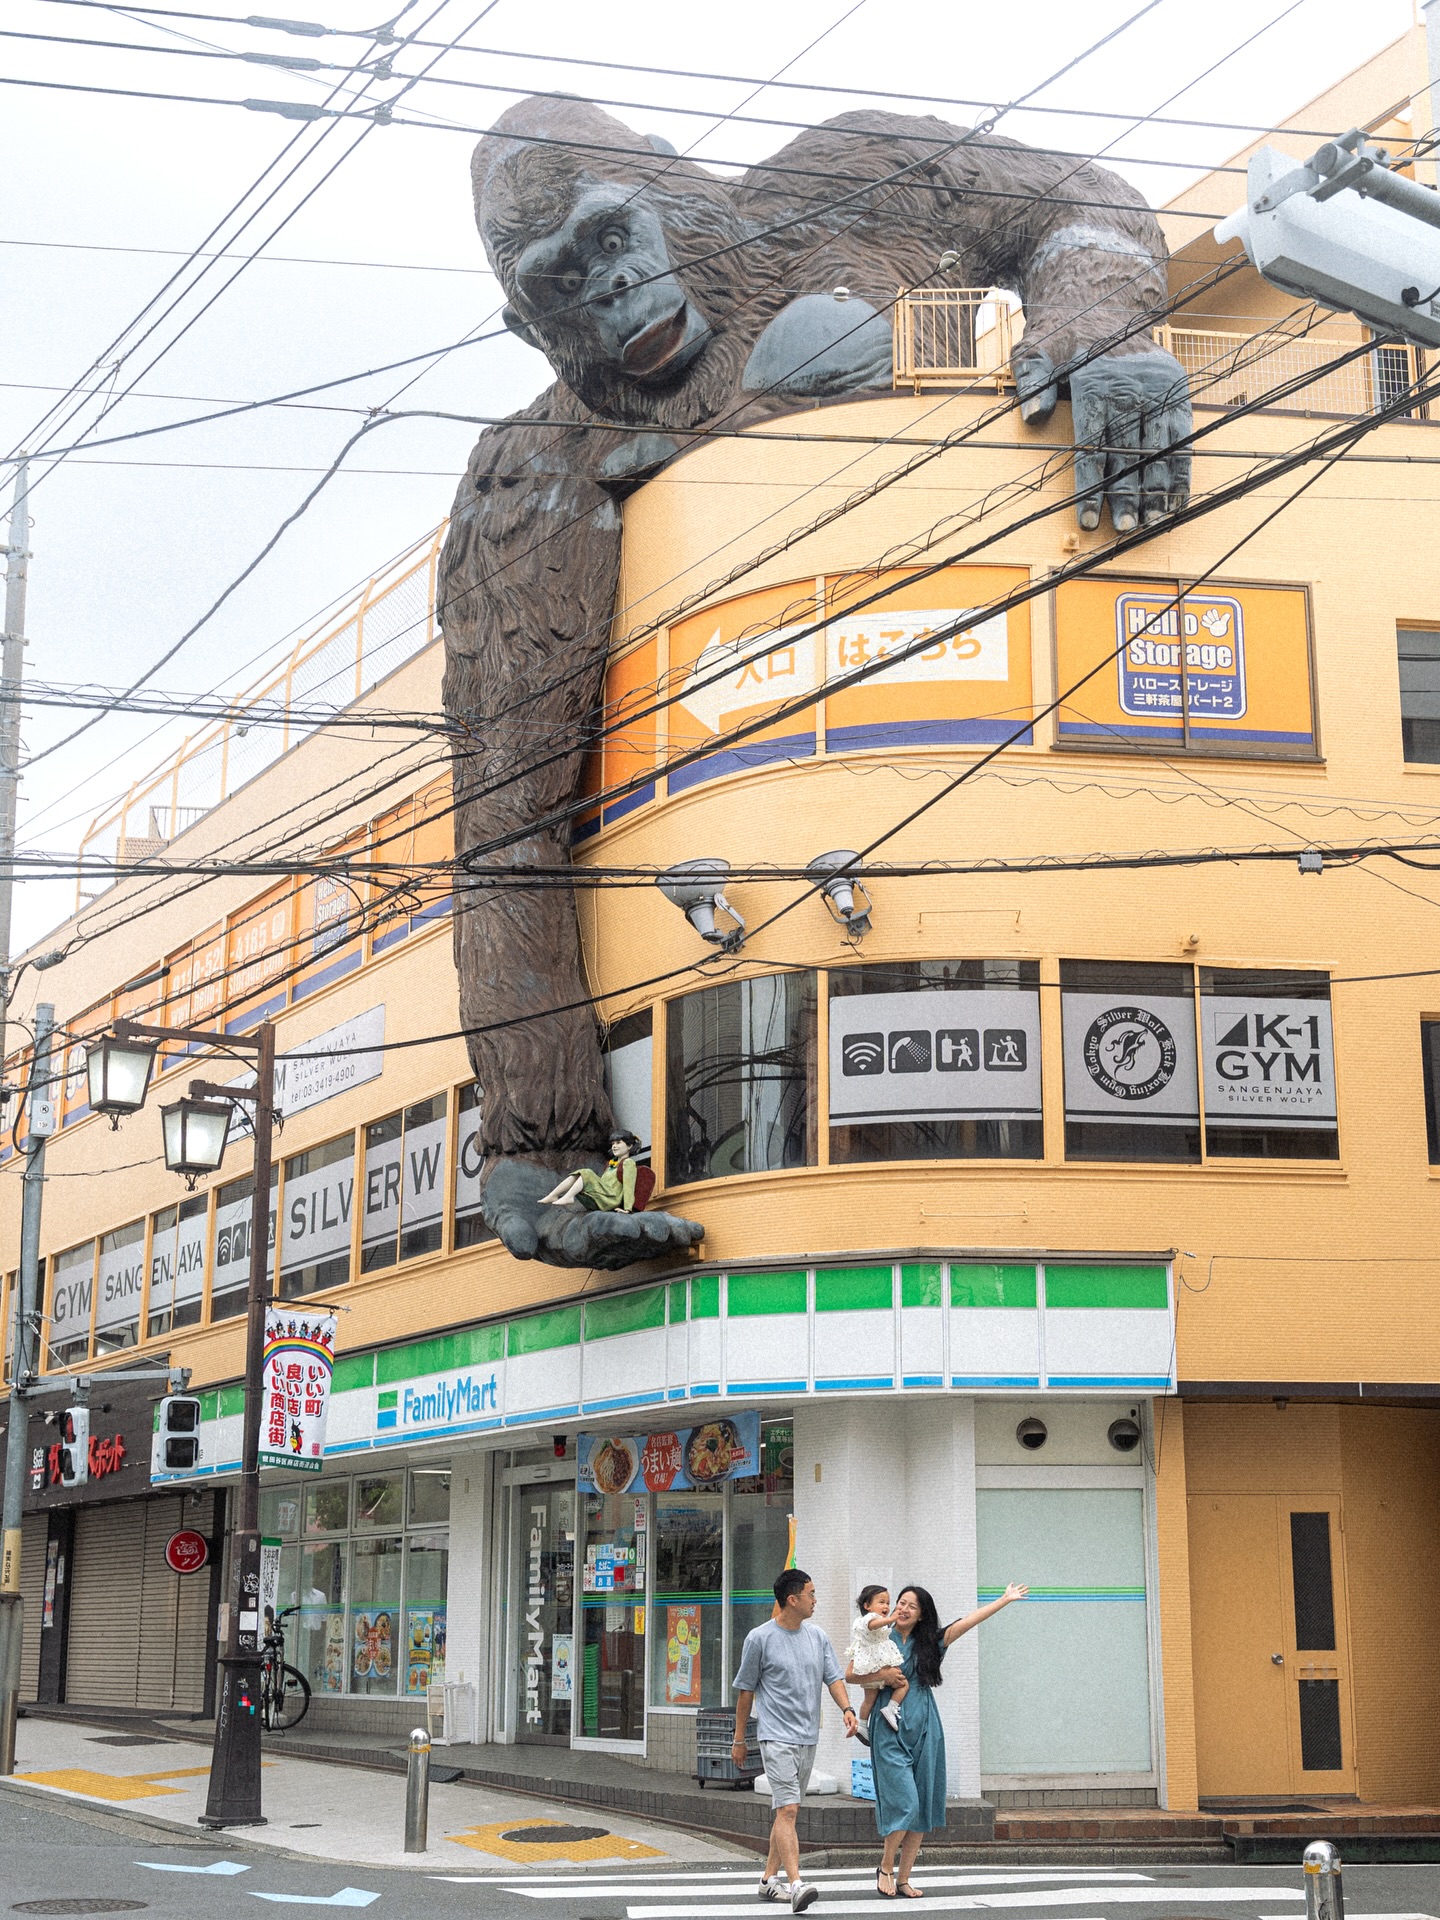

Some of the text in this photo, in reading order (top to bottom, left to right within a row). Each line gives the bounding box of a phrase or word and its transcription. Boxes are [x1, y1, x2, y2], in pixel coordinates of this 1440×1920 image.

[1128, 607, 1198, 636] Hello
[735, 646, 796, 690] 入口
[1130, 637, 1232, 670] Storage
[1132, 677, 1233, 693] ハローストレージ
[1254, 1013, 1320, 1050] K-1
[295, 1062, 325, 1082] SILVER
[1086, 1010, 1174, 1098] Tokyo Silver Wolf Kick Boxing Gym
[1215, 1050, 1321, 1083] GYM
[1218, 1085, 1322, 1095] SANGENJAYA
[290, 1161, 402, 1240] SILVER
[54, 1277, 94, 1323] GYM
[269, 1358, 286, 1447] いい商店街
[286, 1363, 303, 1417] 良い店
[304, 1365, 326, 1416] いい町
[403, 1373, 497, 1424] FamilyMart
[641, 1445, 683, 1476] うまい麺
[525, 1504, 546, 1724] FamilyMart
